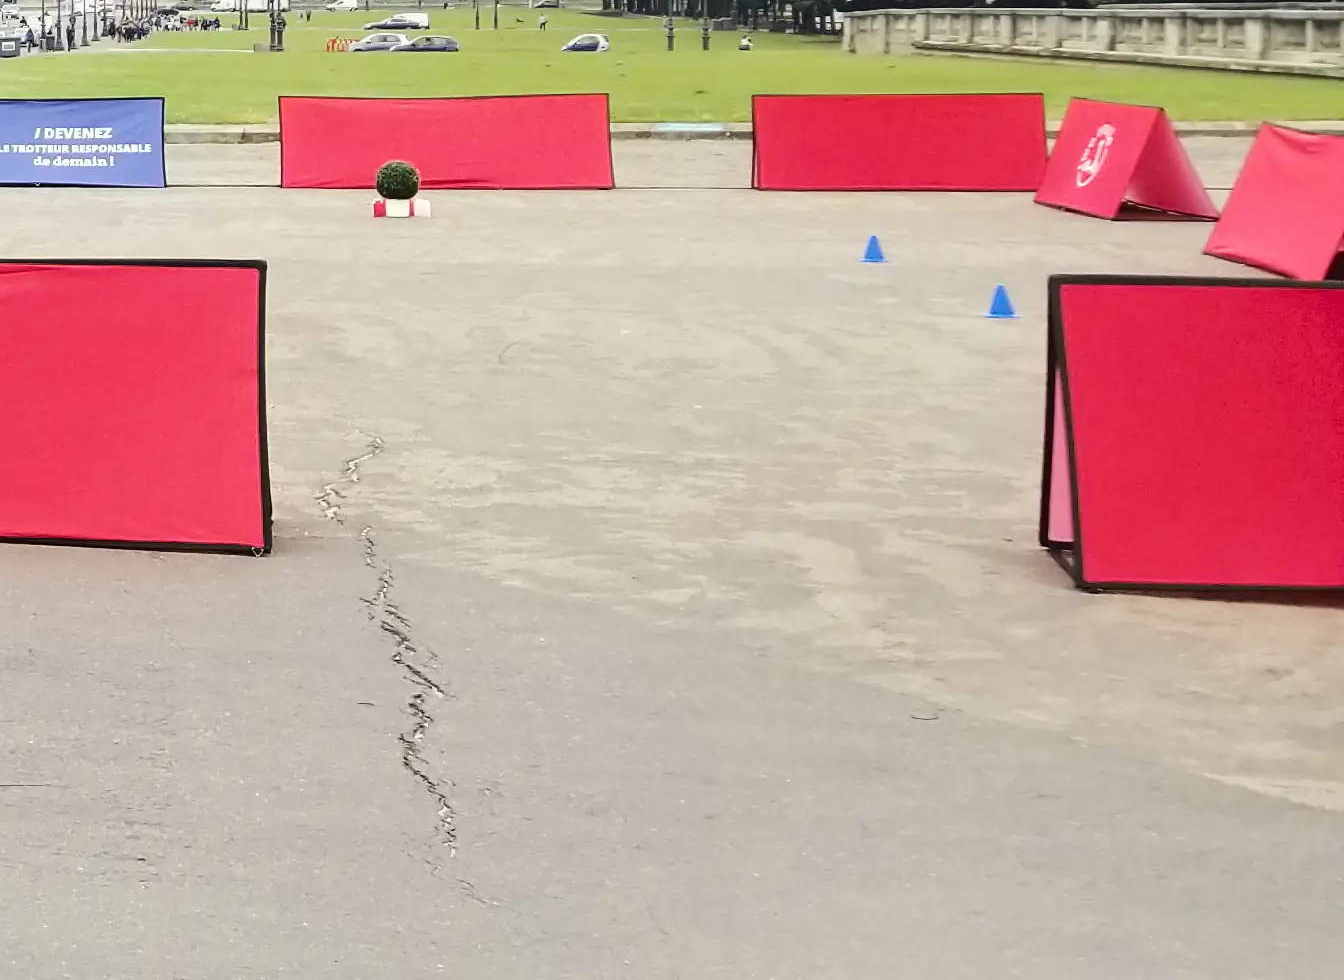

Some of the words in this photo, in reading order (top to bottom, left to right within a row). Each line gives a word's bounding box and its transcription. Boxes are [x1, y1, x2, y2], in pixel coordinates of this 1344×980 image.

[43, 127, 113, 140] DEVENEZ
[12, 144, 70, 153] TROTTEUR
[71, 143, 152, 153] RESPONSABLE
[33, 156, 51, 167] de
[52, 155, 109, 167] demain
